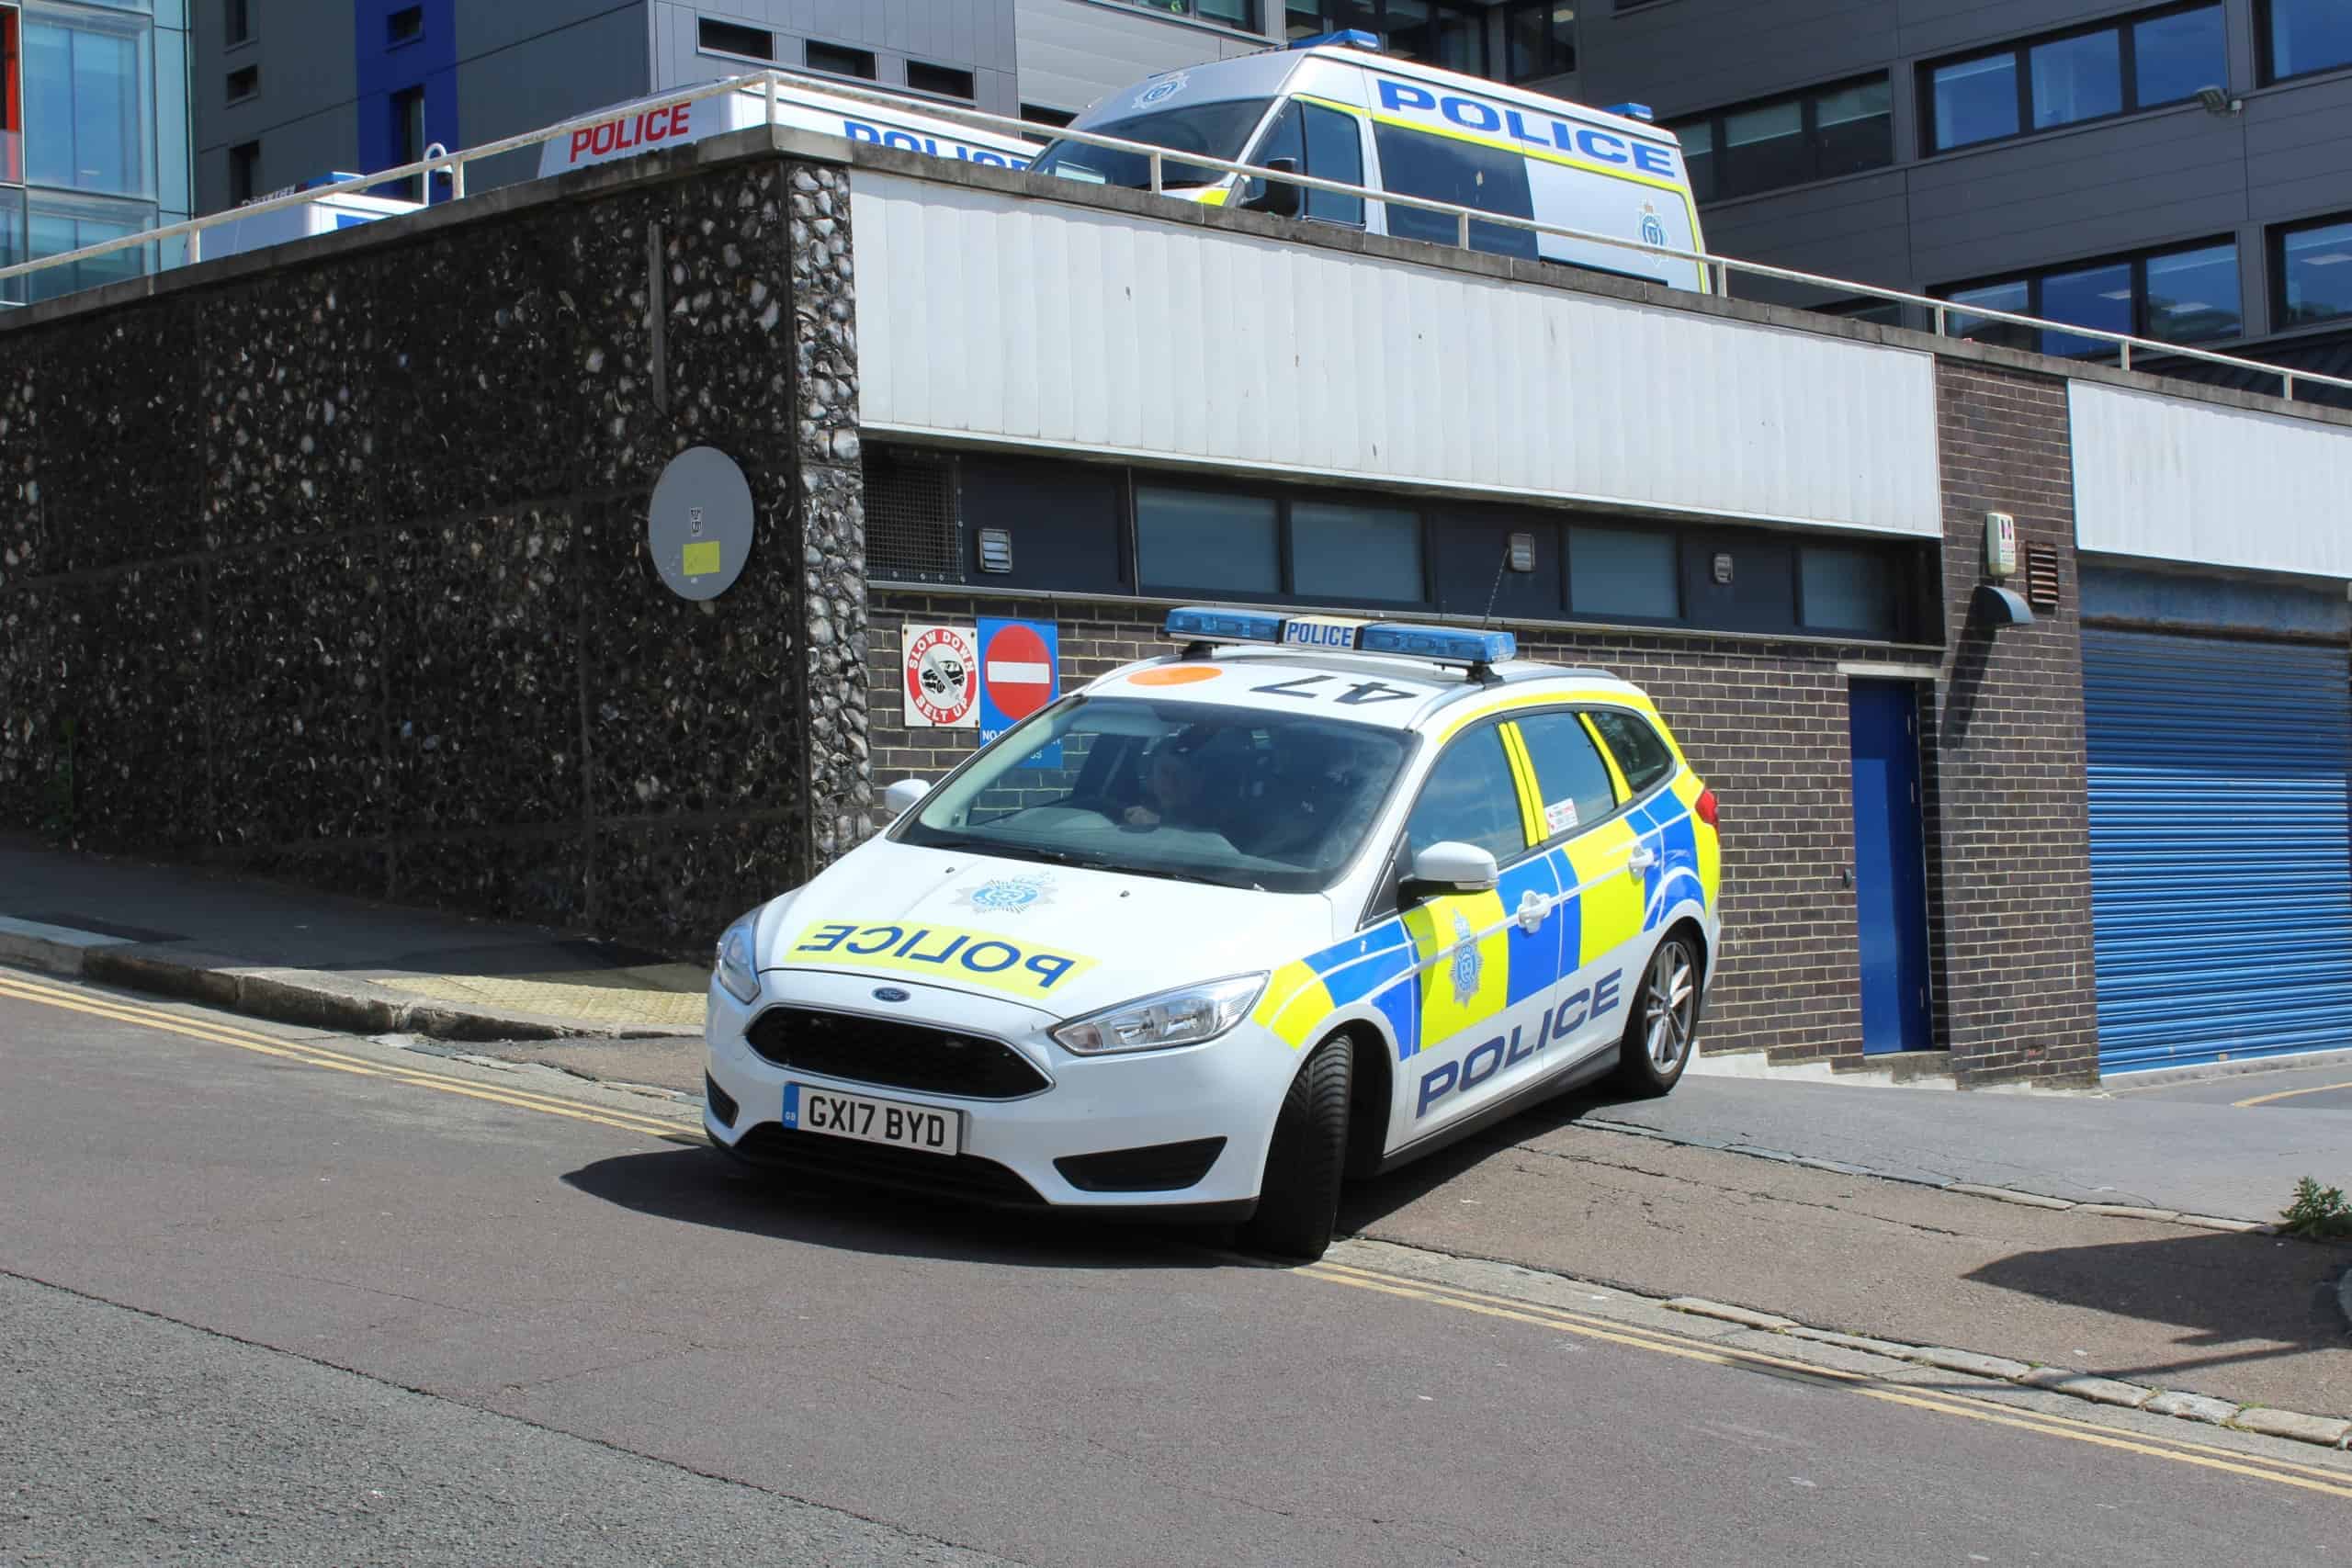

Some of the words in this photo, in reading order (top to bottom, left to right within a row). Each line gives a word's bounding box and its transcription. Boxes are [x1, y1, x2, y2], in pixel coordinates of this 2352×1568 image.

[570, 101, 691, 163] POLICE
[1377, 79, 1675, 177] POLICE
[909, 631, 936, 670] SLOW
[943, 631, 975, 672] DOWN
[1286, 622, 1352, 647] POLICE
[953, 697, 968, 716] UP
[982, 729, 998, 741] NO
[1416, 968, 1623, 1119] POLICE
[808, 1096, 876, 1134] GX17
[885, 1108, 944, 1146] BYD
